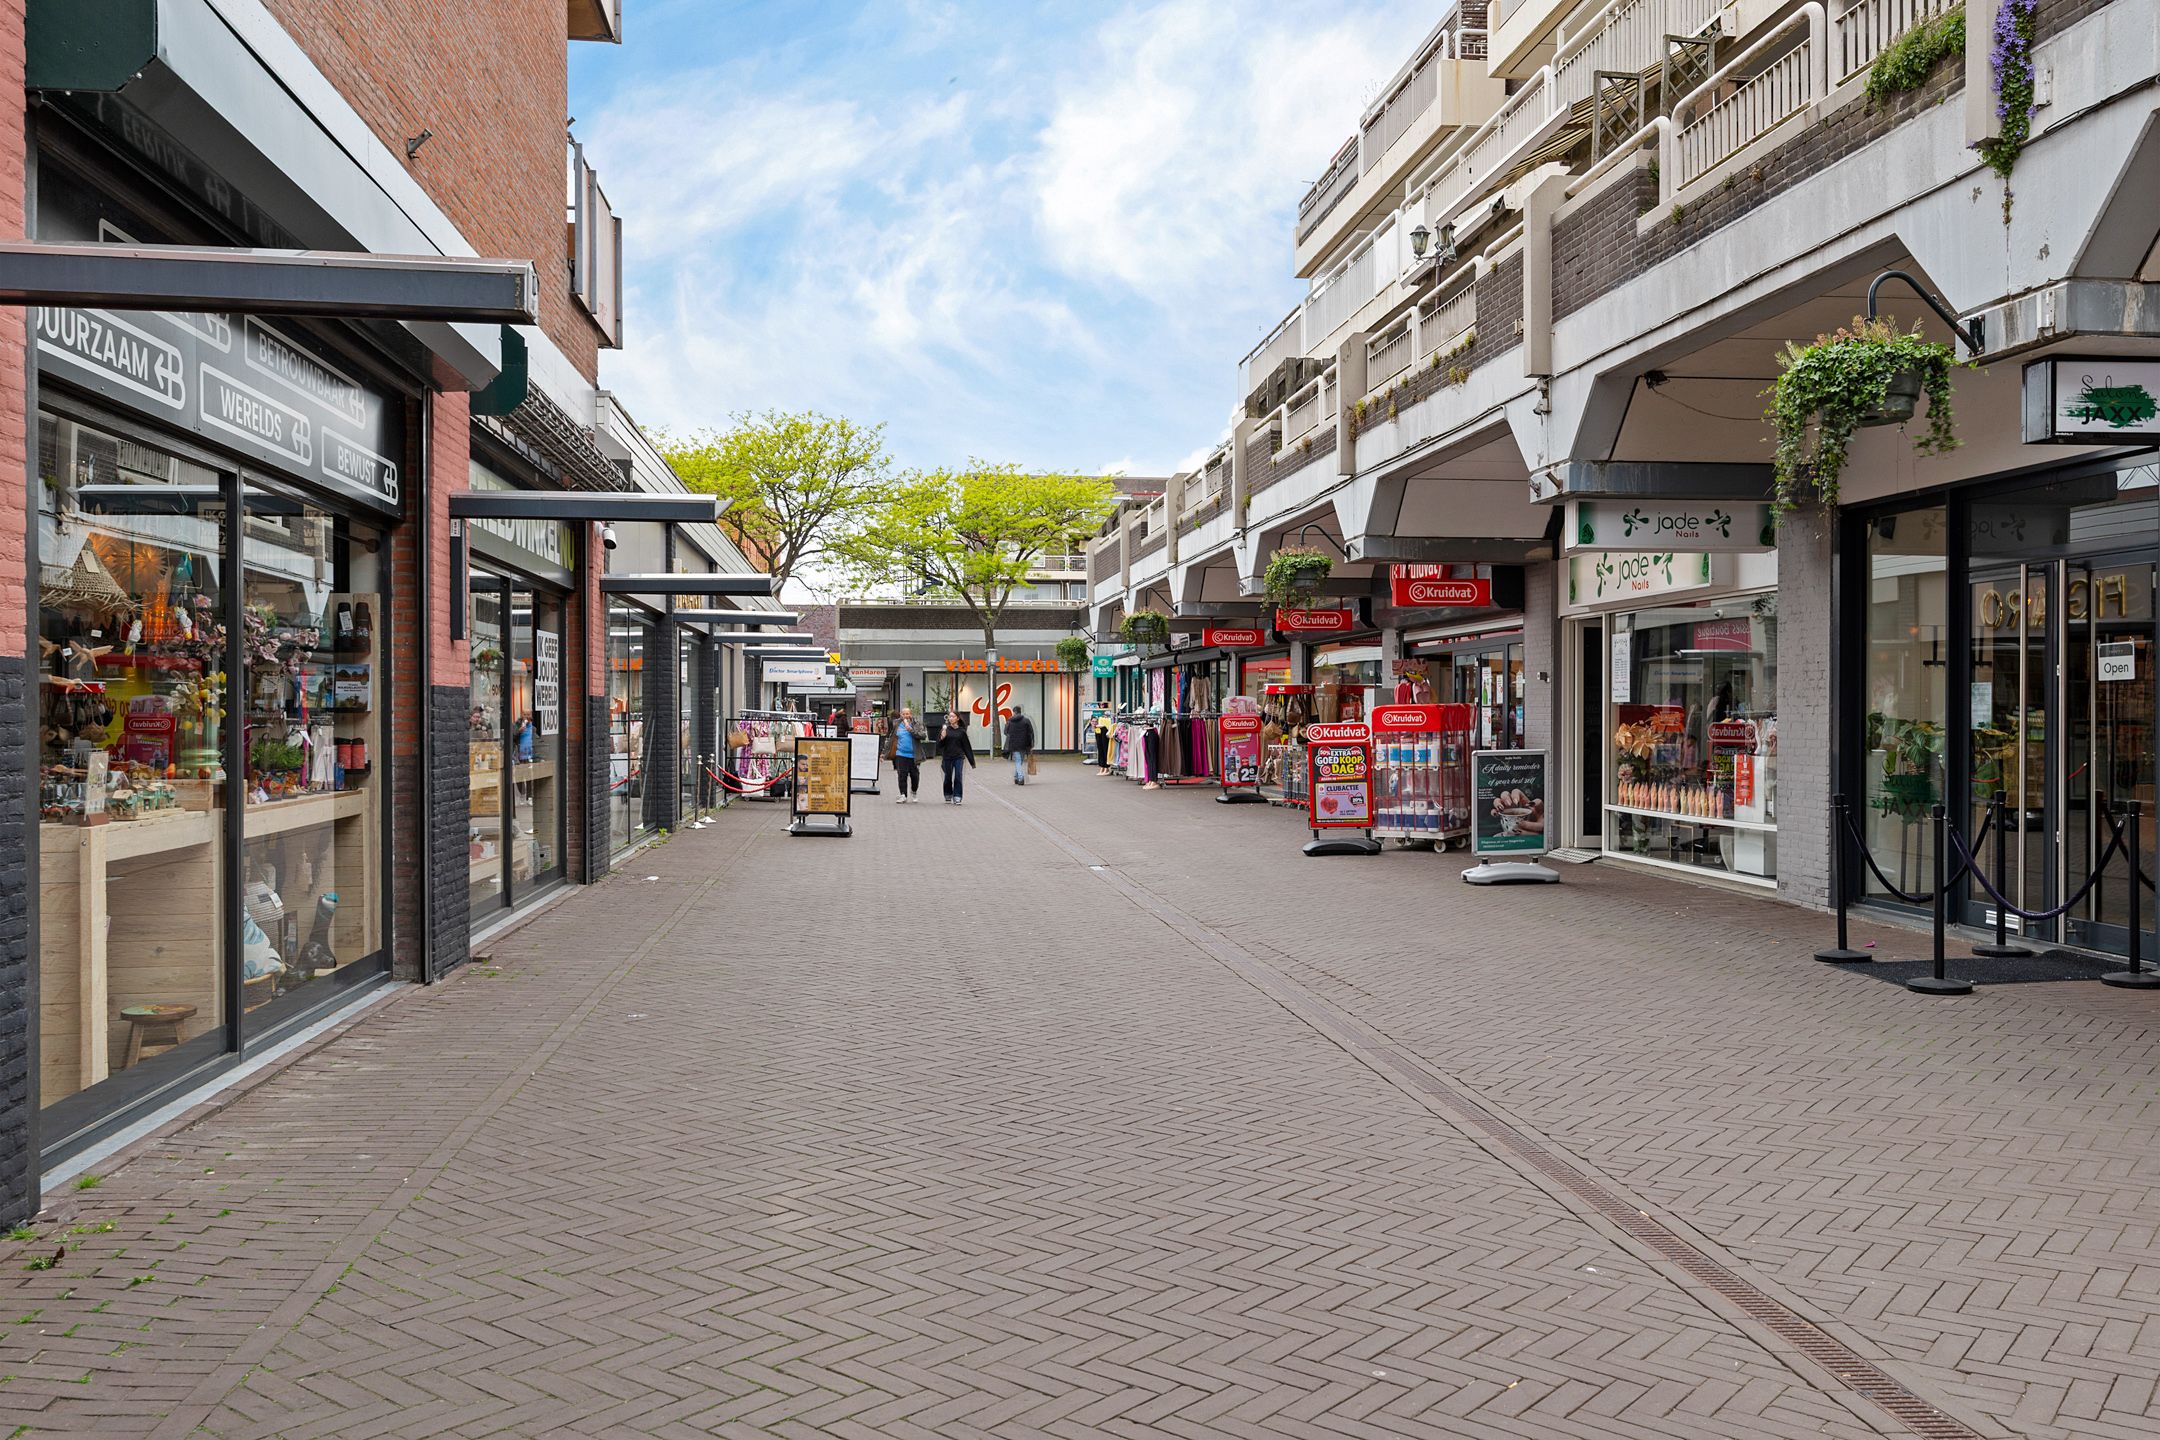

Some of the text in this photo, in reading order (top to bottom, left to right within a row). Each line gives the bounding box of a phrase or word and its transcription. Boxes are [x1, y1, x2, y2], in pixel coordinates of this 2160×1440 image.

[259, 333, 345, 408] BETROUWBAAR
[220, 386, 282, 442] WERELDS
[2081, 406, 2142, 425] JAXX
[337, 446, 376, 486] BEWUST
[1654, 512, 1700, 534] jade
[1675, 530, 1700, 538] Nails
[1616, 552, 1649, 589] jade
[1631, 579, 1650, 591] Nails
[1426, 586, 1472, 598] Kruidvat
[1302, 615, 1338, 625] Kruidvat
[1223, 630, 1253, 641] Kruidvat
[537, 635, 544, 658] IK
[539, 661, 558, 683] JOU DE
[2104, 662, 2129, 675] Open
[535, 684, 558, 706] WERELD
[542, 709, 558, 731] KADO
[1392, 713, 1422, 723] Kruidvat
[1323, 726, 1366, 737] Kruidvat
[1331, 763, 1355, 774] DAG
[1512, 763, 1541, 771] reminder
[1494, 779, 1510, 787] your
[1524, 776, 1537, 785] self
[1326, 784, 1359, 792] CLUBACTIE
